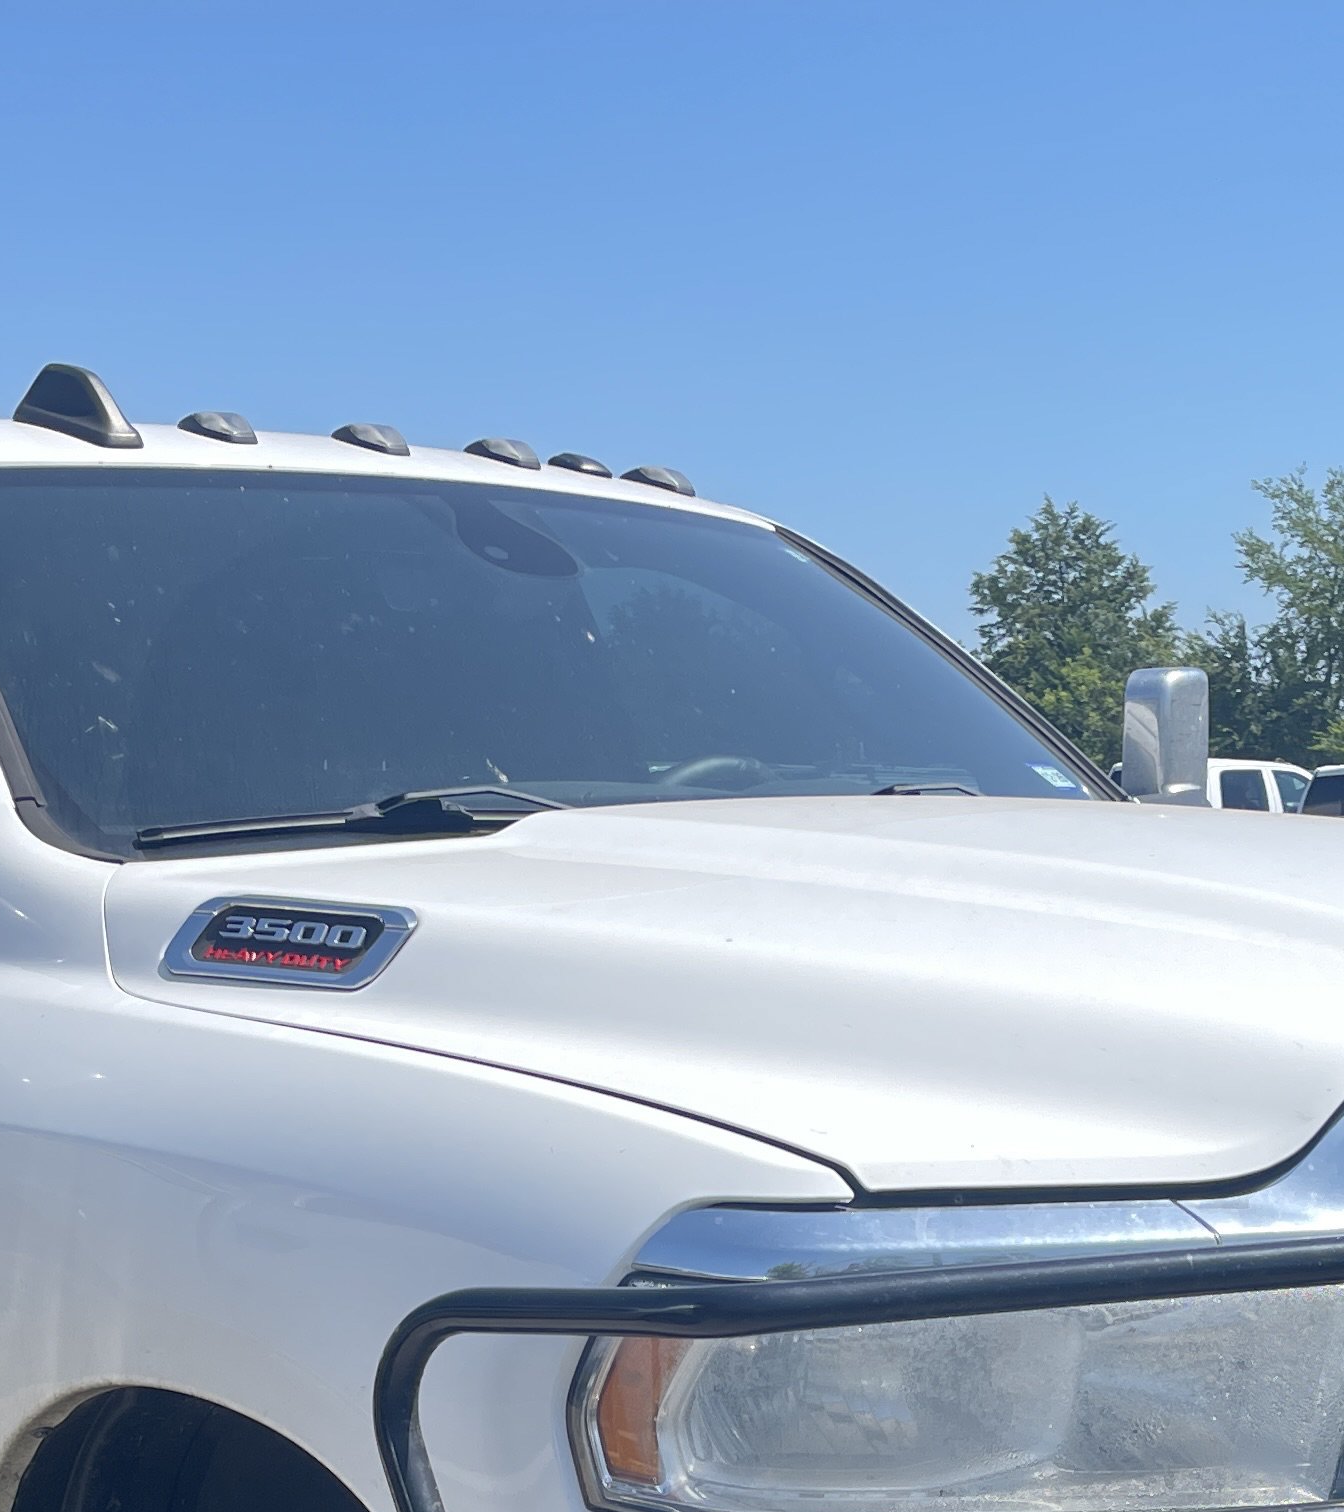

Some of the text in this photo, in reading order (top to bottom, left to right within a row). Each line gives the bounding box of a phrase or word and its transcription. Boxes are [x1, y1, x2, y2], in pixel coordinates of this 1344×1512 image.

[219, 915, 367, 948] 3500
[203, 944, 352, 972] HEAVY DUTY
